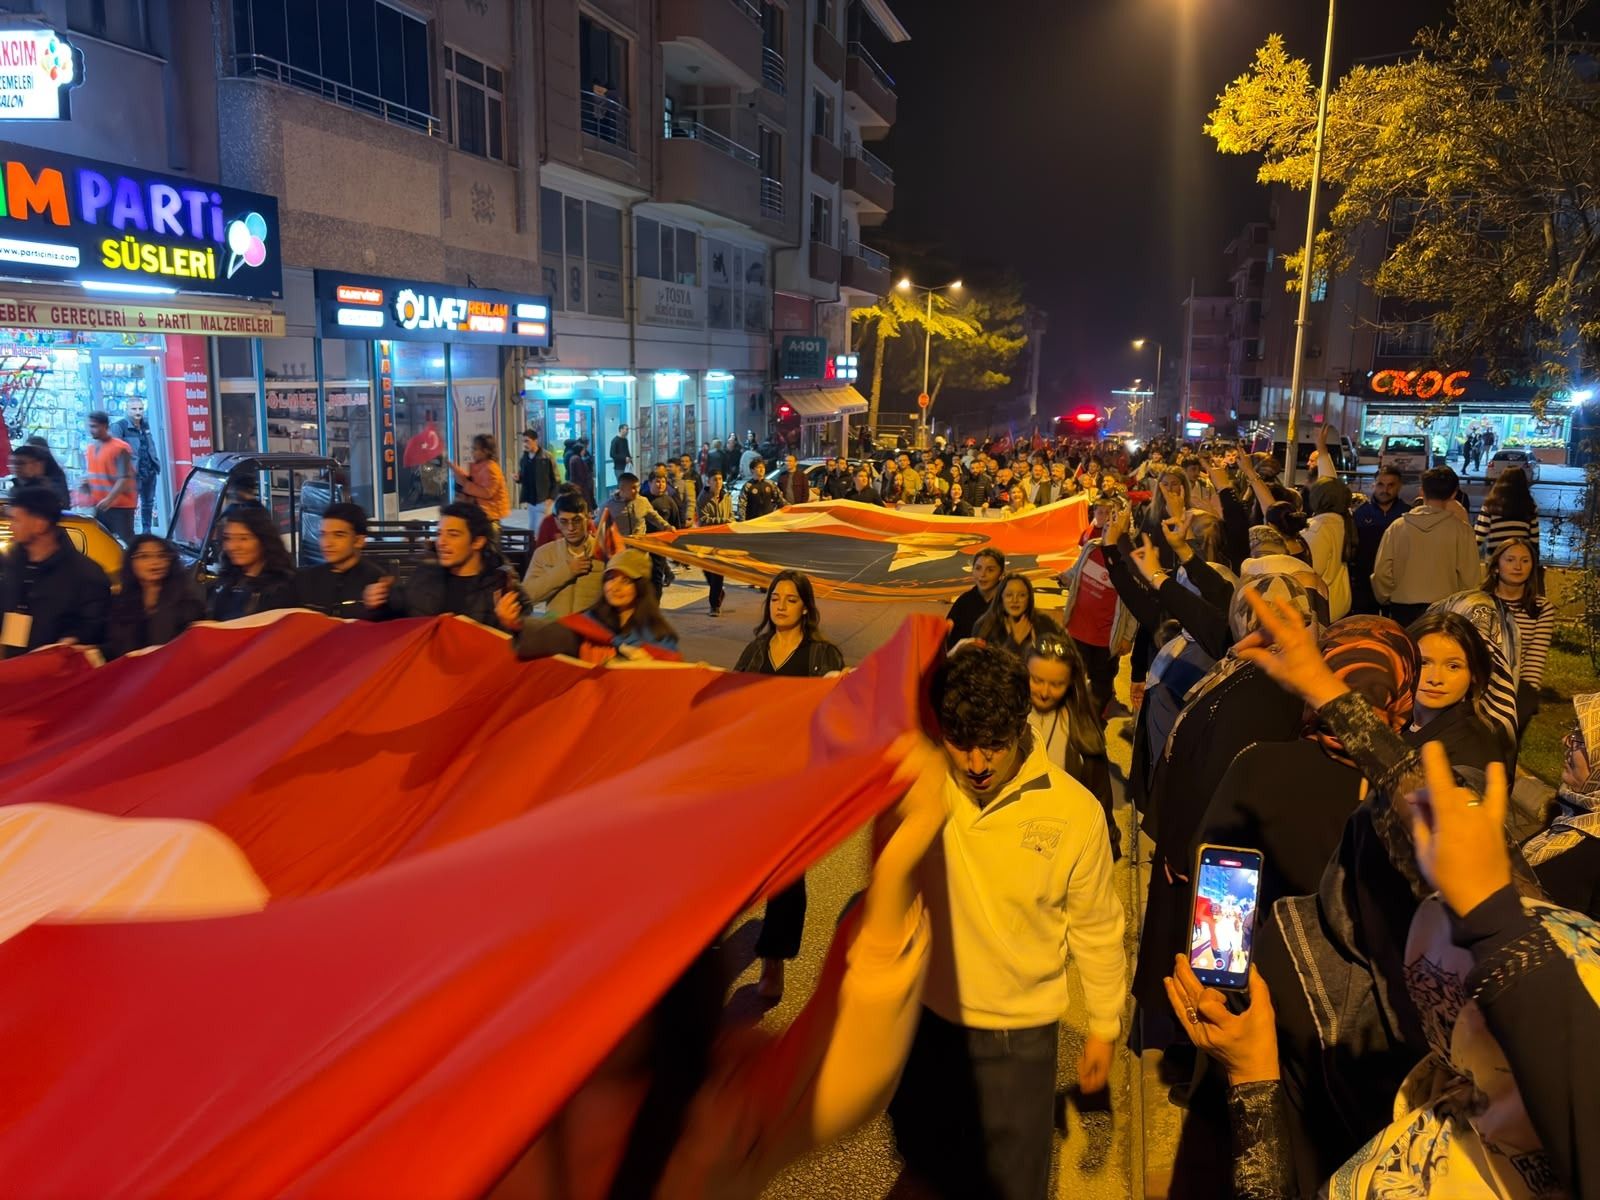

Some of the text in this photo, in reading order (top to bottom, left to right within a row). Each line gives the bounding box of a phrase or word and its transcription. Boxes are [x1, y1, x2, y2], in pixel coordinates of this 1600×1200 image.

[101, 235, 216, 280] SÜSLERİ
[665, 287, 691, 305] TOSYA
[51, 306, 126, 329] GEREÇLERİ
[138, 311, 147, 327] &
[157, 312, 191, 330] PARTİ
[200, 314, 274, 334] MALZEMELERİ
[468, 300, 508, 317] REKLAM
